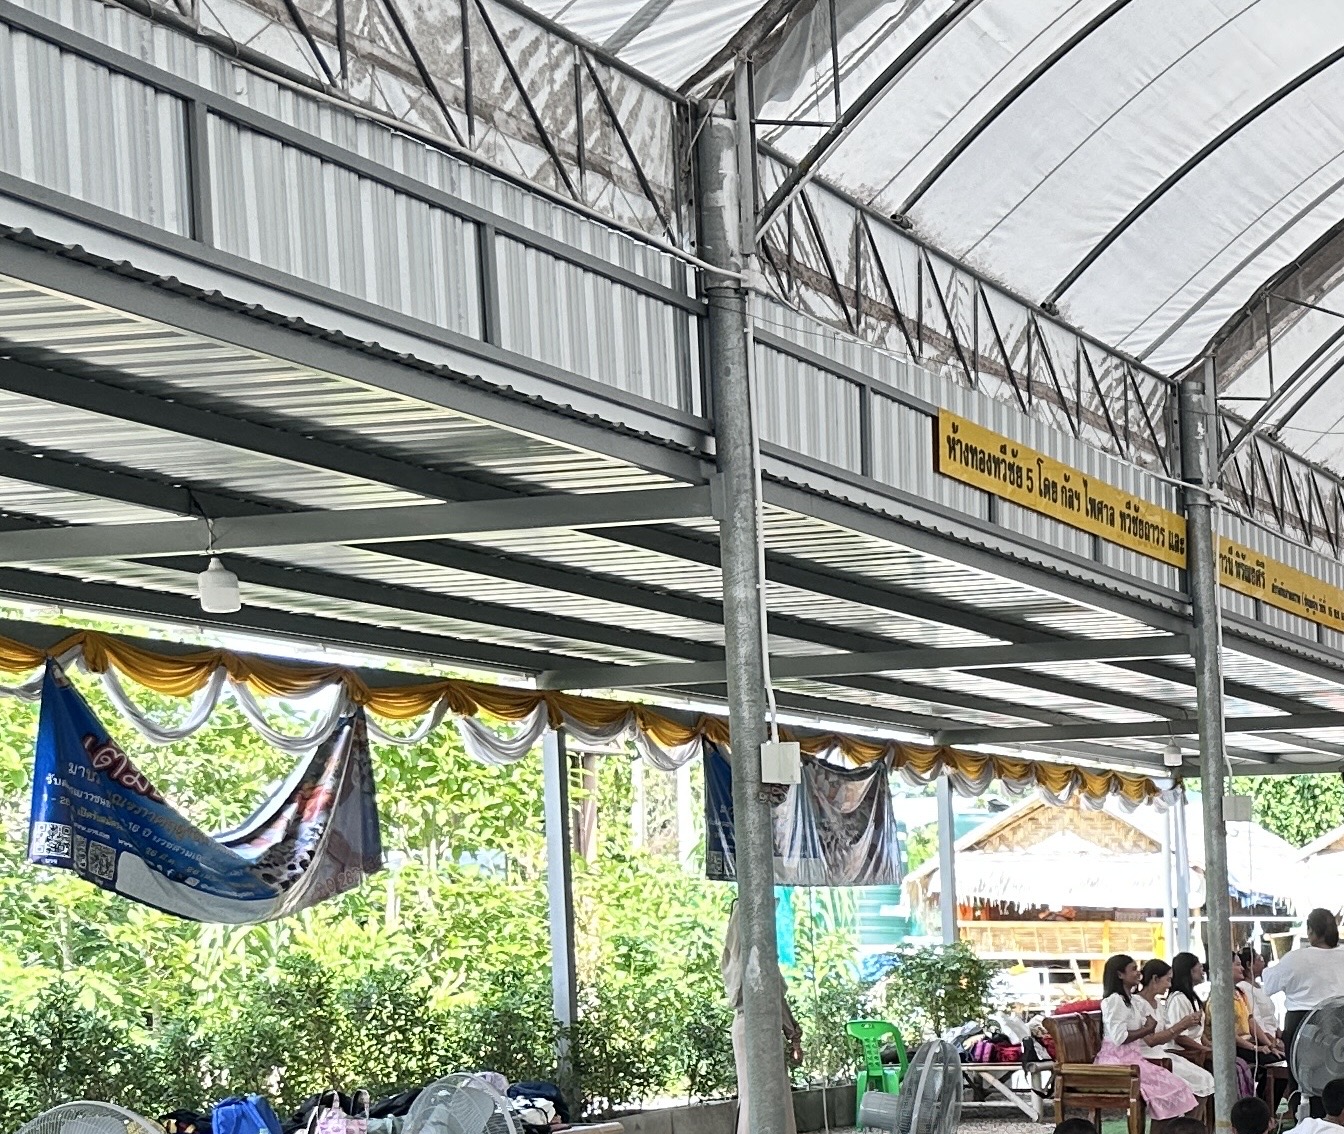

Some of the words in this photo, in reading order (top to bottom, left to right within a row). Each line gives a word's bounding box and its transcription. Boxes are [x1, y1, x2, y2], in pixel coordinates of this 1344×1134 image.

[946, 422, 1022, 489] ห้างทองทวีชัย
[1026, 467, 1034, 493] 5
[1037, 457, 1058, 503] โดย
[1168, 530, 1185, 555] และ
